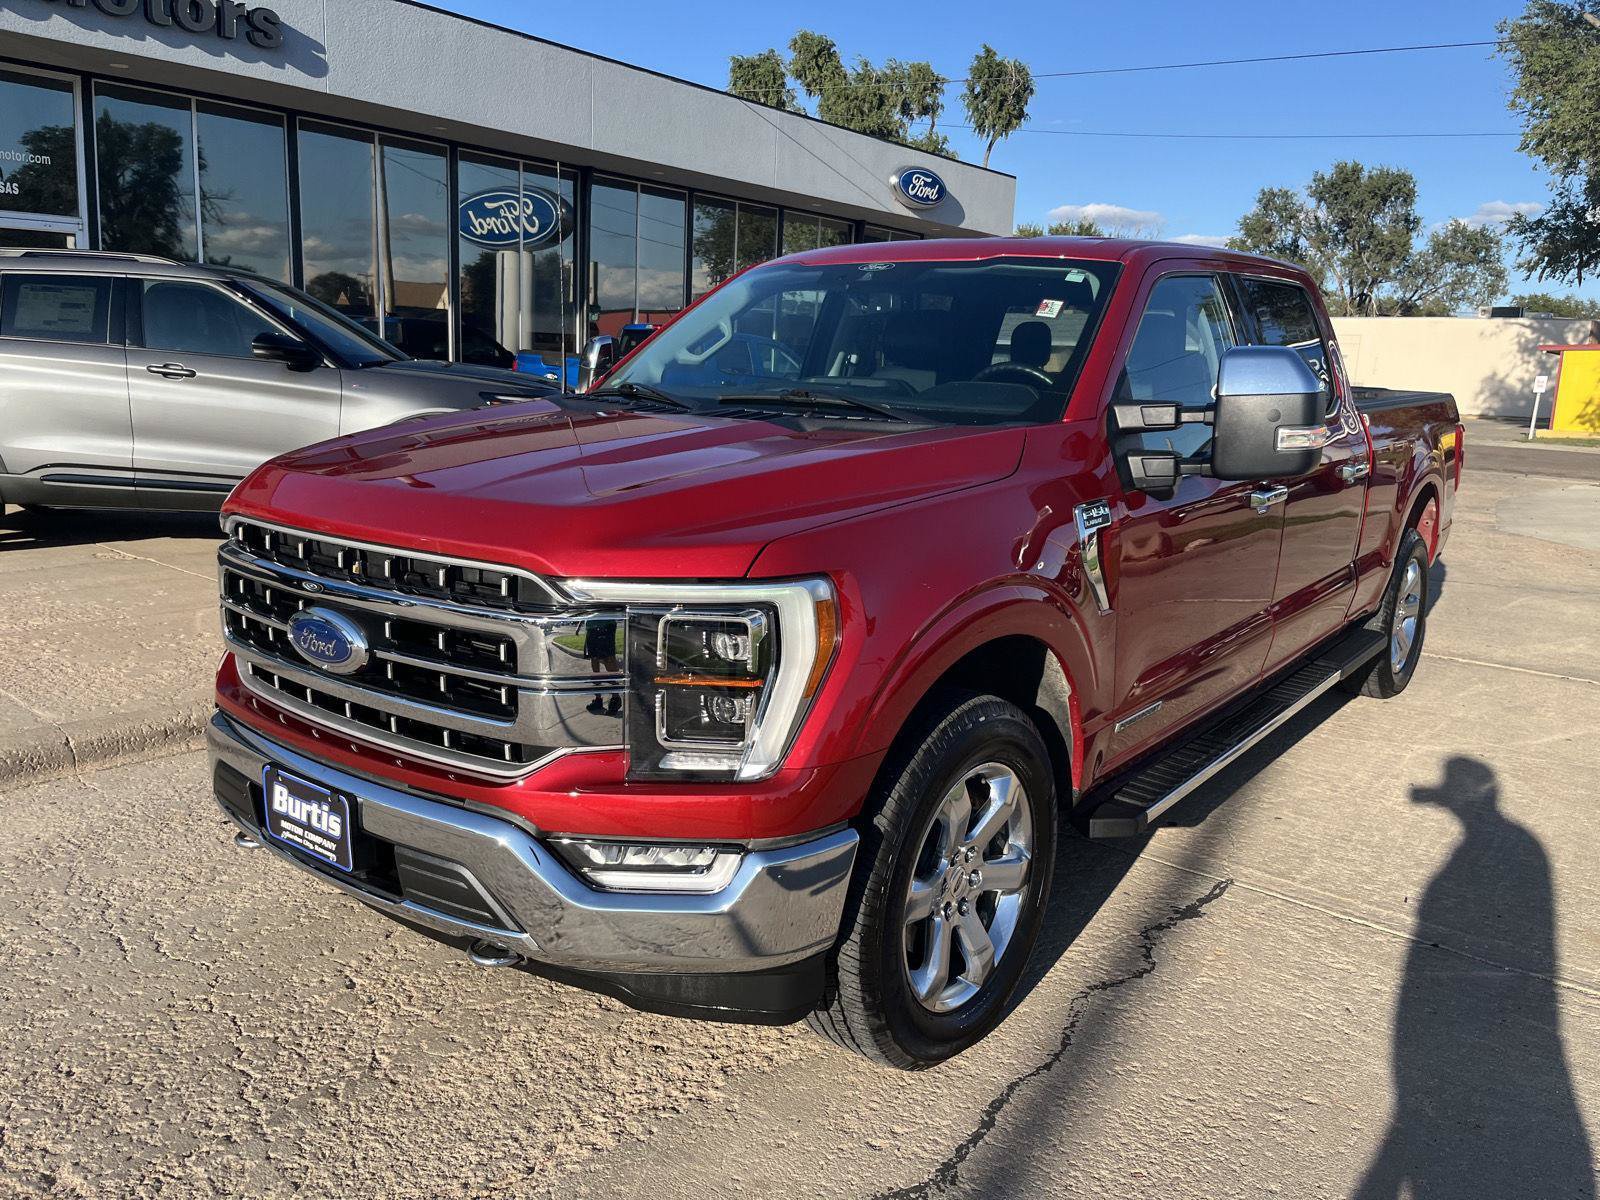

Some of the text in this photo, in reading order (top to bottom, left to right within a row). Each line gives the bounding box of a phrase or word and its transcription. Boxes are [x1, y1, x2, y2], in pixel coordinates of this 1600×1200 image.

[908, 174, 939, 200] Ford
[300, 627, 337, 657] Ford
[273, 782, 341, 838] Burtis
[280, 820, 337, 851] MOTOR COMPANY
